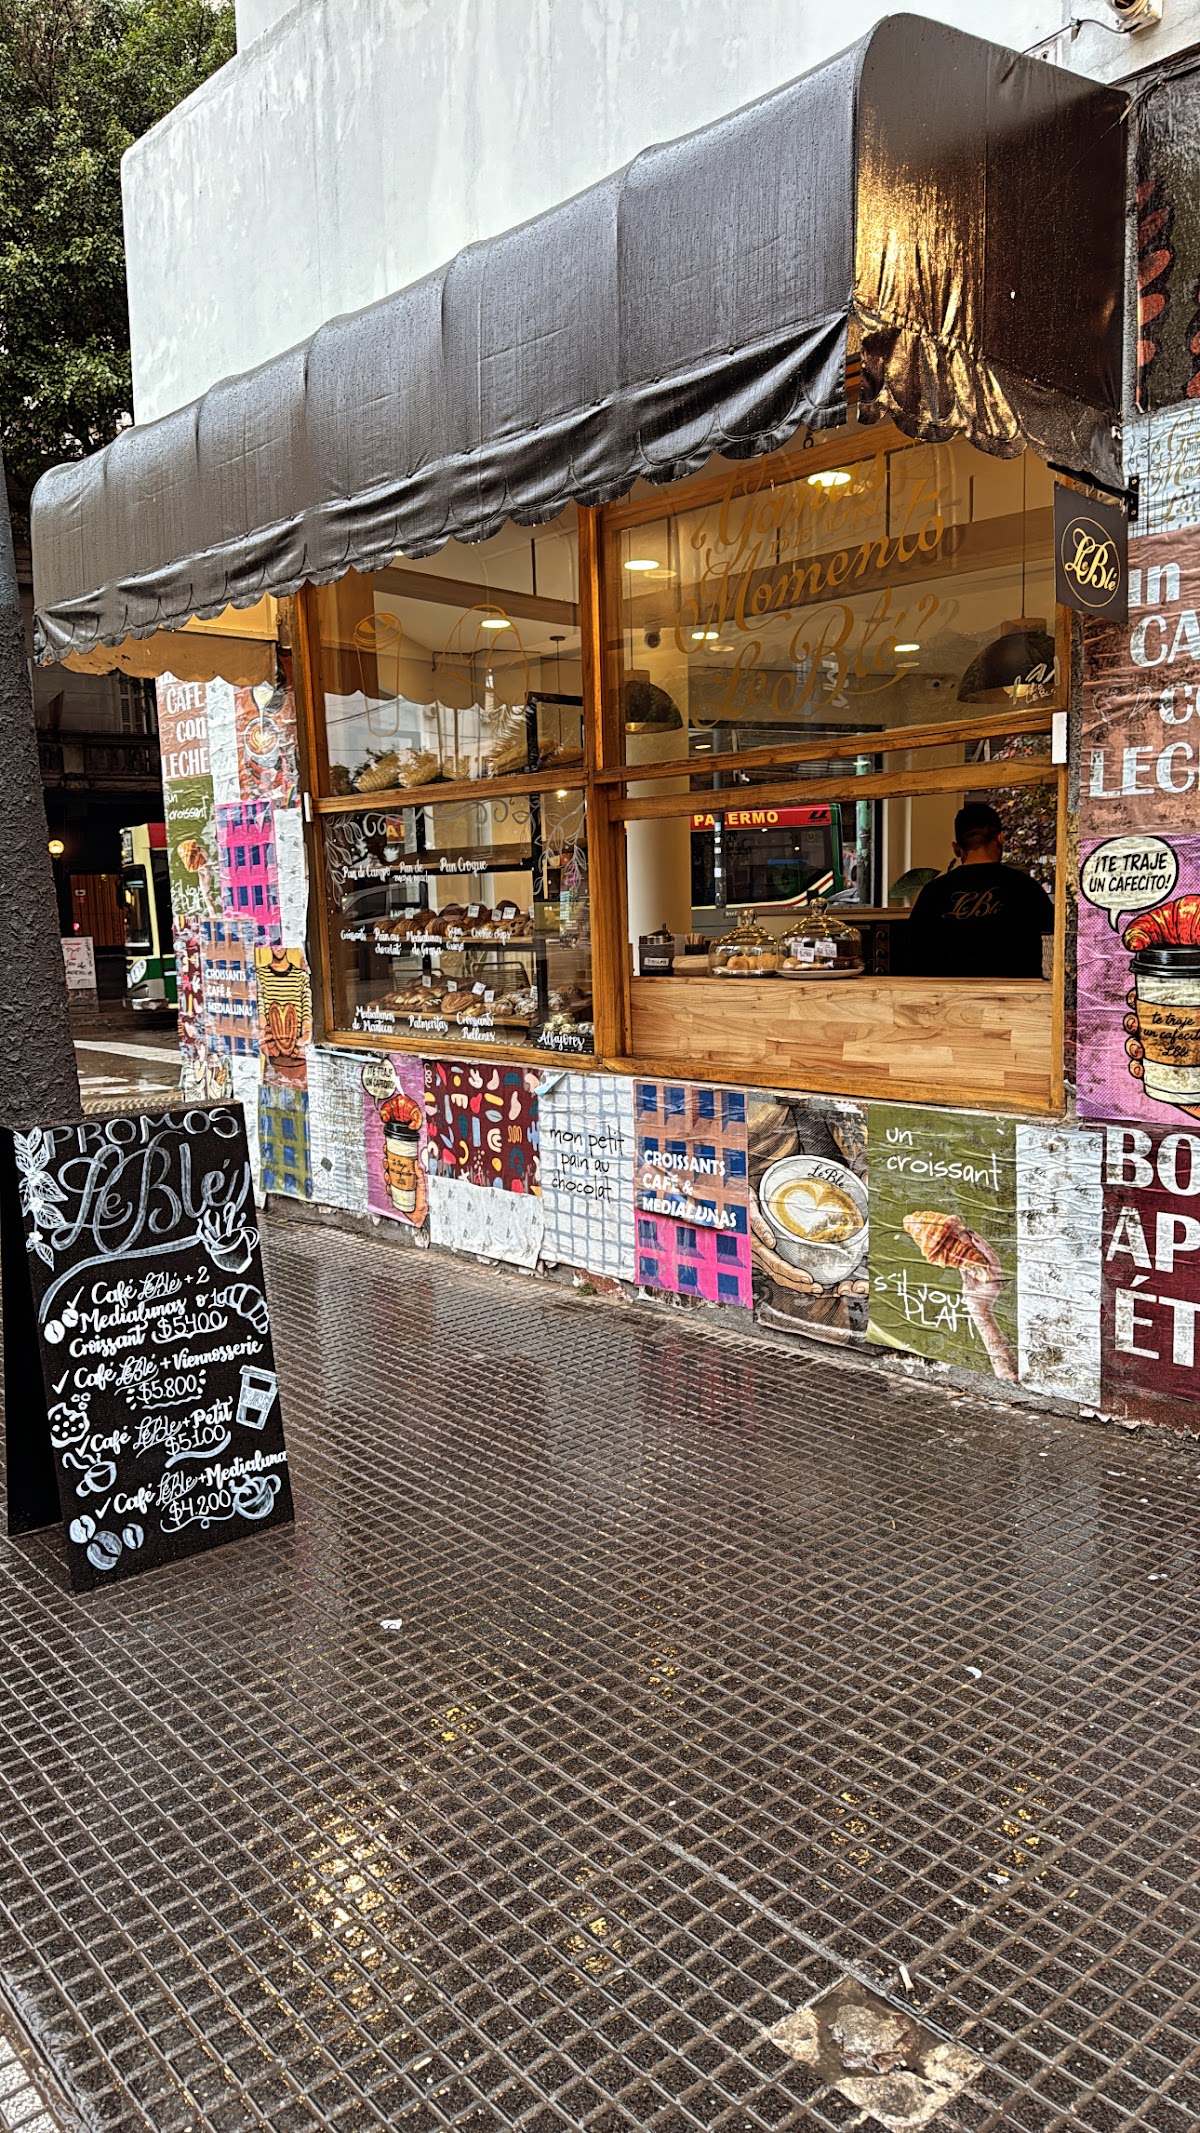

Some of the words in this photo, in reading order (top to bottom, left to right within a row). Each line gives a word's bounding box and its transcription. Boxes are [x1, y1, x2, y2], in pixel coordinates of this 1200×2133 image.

[675, 477, 945, 654] Momento
[161, 747, 210, 781] LECHE
[1089, 742, 1200, 797] LEC
[169, 795, 209, 820] croissant
[693, 811, 779, 826] PAERMO
[400, 860, 414, 874] Pan
[439, 857, 457, 872] Pan
[457, 856, 488, 877] Croque
[1094, 855, 1117, 873] ¡TE
[1123, 852, 1168, 871] TRAJE
[1089, 877, 1106, 892] UN
[1108, 874, 1172, 892] CAFECITO!
[205, 968, 247, 982] CROISSANTS
[207, 1001, 253, 1017] MEDIALUNAS
[1152, 1011, 1163, 1024] te
[1165, 1012, 1195, 1030] traje
[537, 1030, 585, 1051] Alfajores
[1143, 1029, 1158, 1037] un
[43, 1108, 241, 1158] PROMOS
[550, 1129, 582, 1146] mon
[589, 1125, 624, 1158] petit
[886, 1127, 913, 1146] un
[561, 1150, 589, 1175] pain
[595, 1160, 610, 1173] au
[644, 1150, 725, 1176] CROISSANTS
[887, 1152, 1002, 1191] croissant
[552, 1170, 612, 1203] chocolat
[642, 1173, 680, 1192] CAFÉ
[682, 1180, 694, 1196] &
[642, 1196, 737, 1228] MEDIALUNAS
[91, 1278, 137, 1308] Café
[196, 1266, 210, 1284] 2
[918, 1284, 976, 1311] vous
[79, 1298, 187, 1333] Medialunas
[1114, 1275, 1200, 1368] ÉT
[69, 1324, 148, 1357] Croissant
[74, 1361, 117, 1390] Café
[90, 1425, 132, 1454] Café
[113, 1482, 156, 1514] Café
